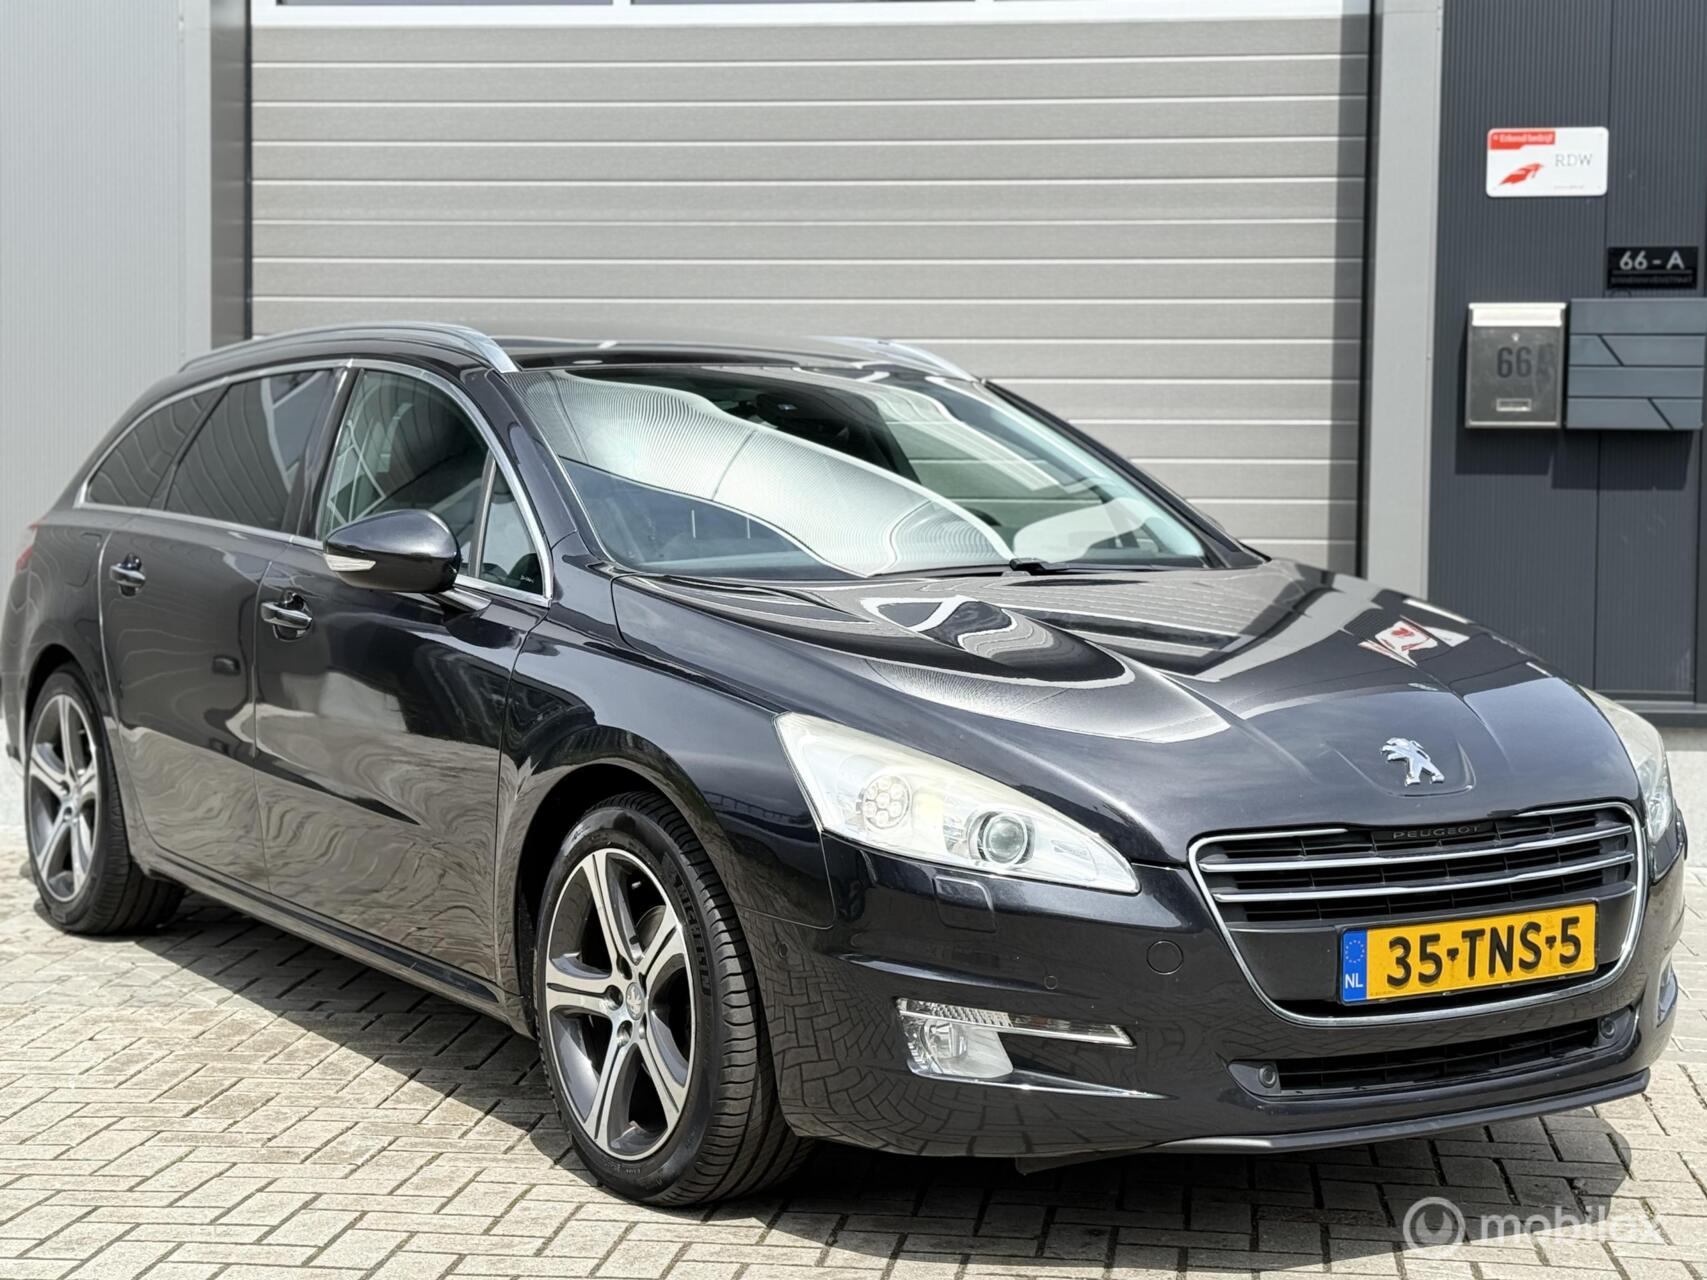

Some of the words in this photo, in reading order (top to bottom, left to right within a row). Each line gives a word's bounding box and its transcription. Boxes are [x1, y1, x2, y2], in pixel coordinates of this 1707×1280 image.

[1555, 153, 1593, 167] RDW
[1393, 825, 1479, 840] PEUGEOT
[1387, 916, 1581, 988] 35-TNS-5
[1345, 973, 1363, 989] NL
